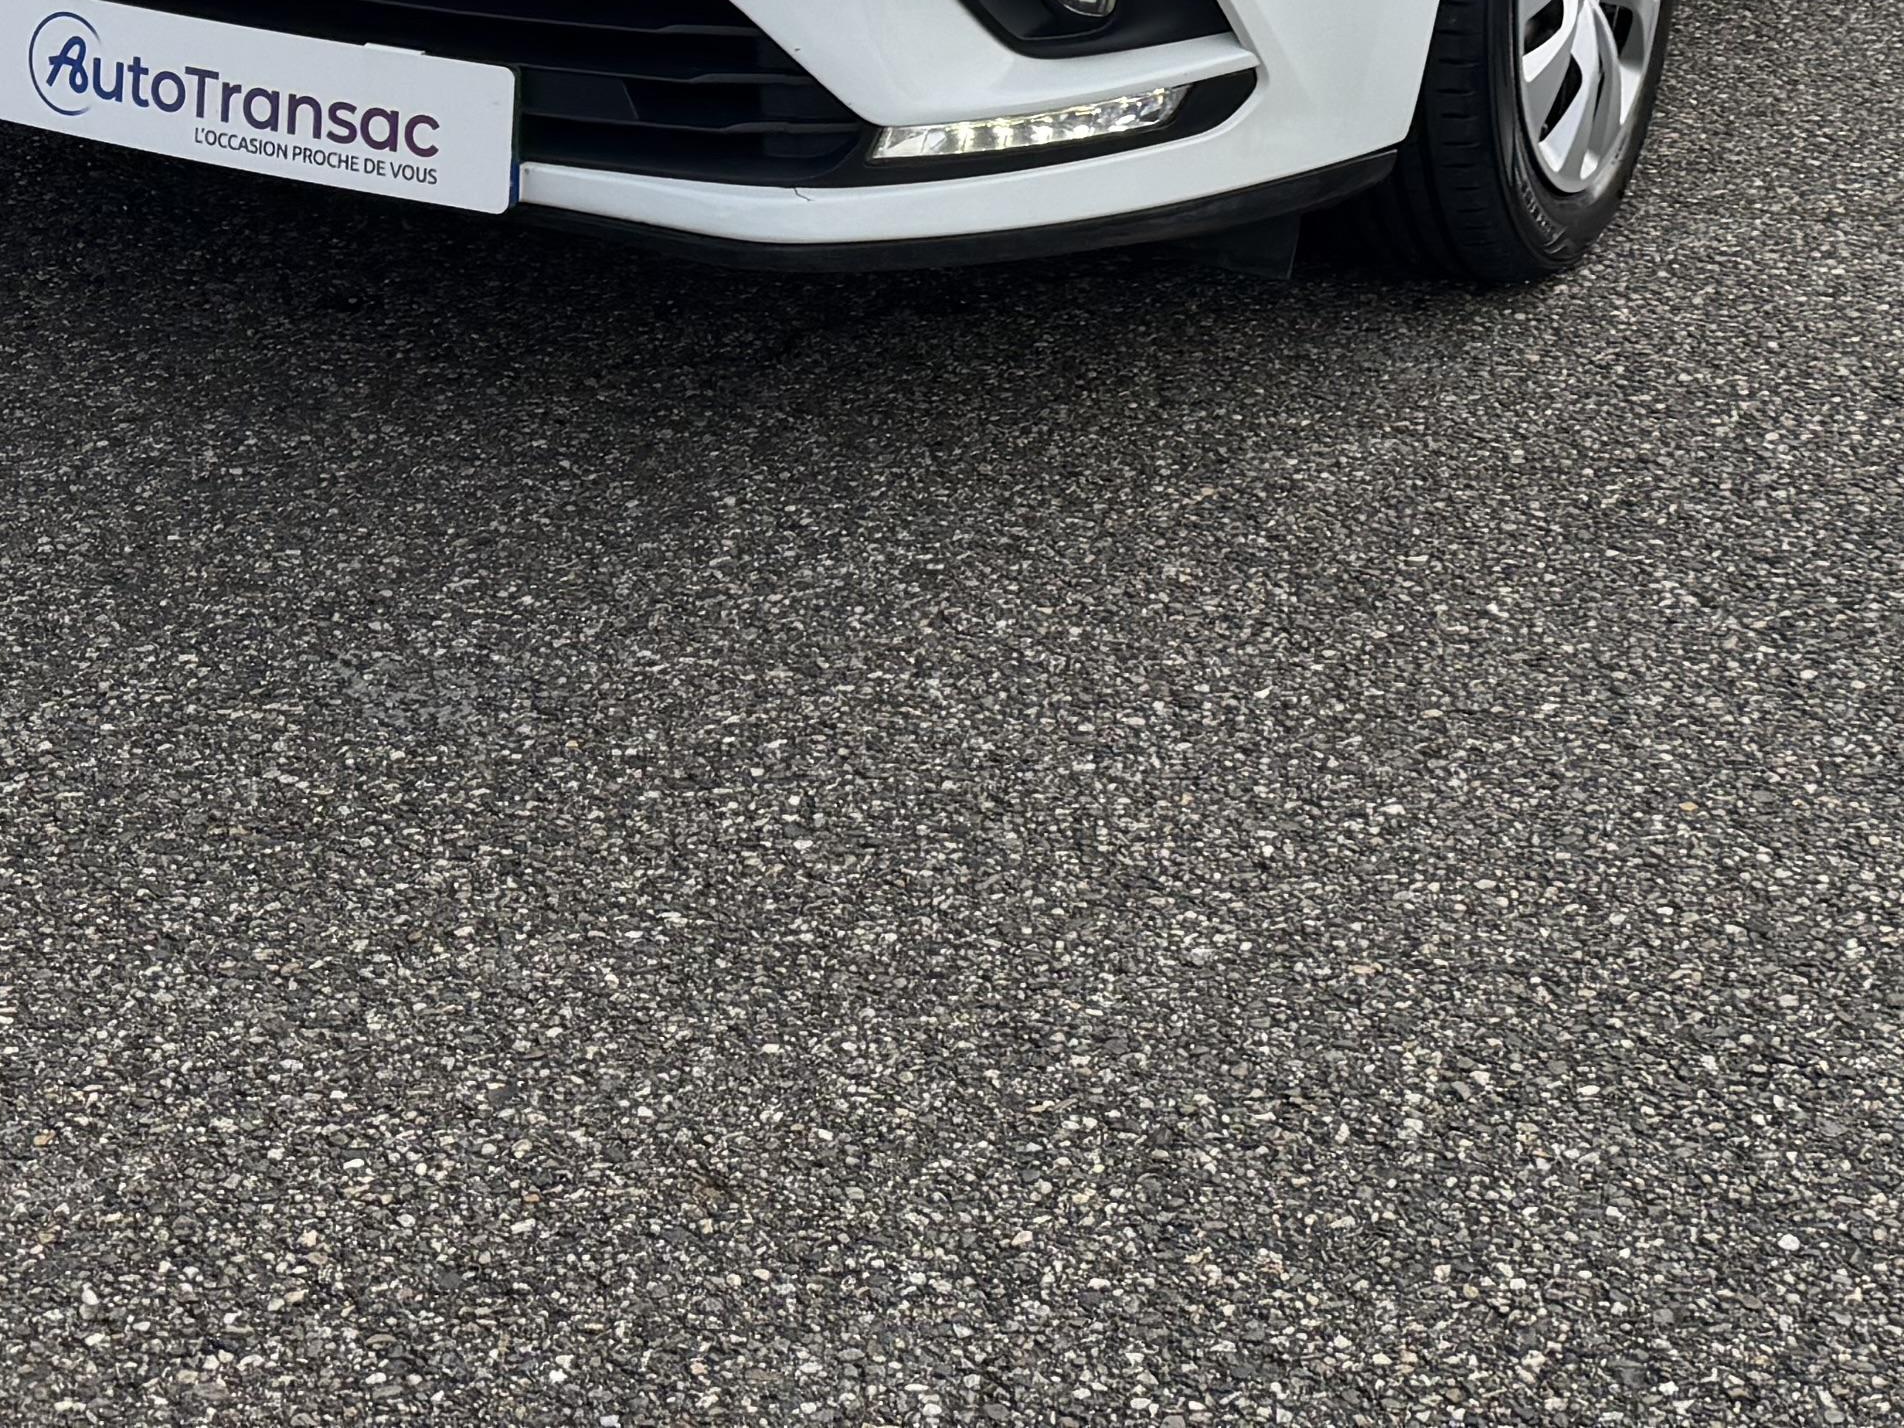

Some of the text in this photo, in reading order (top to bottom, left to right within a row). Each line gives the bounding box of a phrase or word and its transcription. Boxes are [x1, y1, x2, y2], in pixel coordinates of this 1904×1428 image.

[47, 34, 441, 158] AutoTransac
[194, 127, 438, 186] L'OCCASION PROCHE DE VOUS
